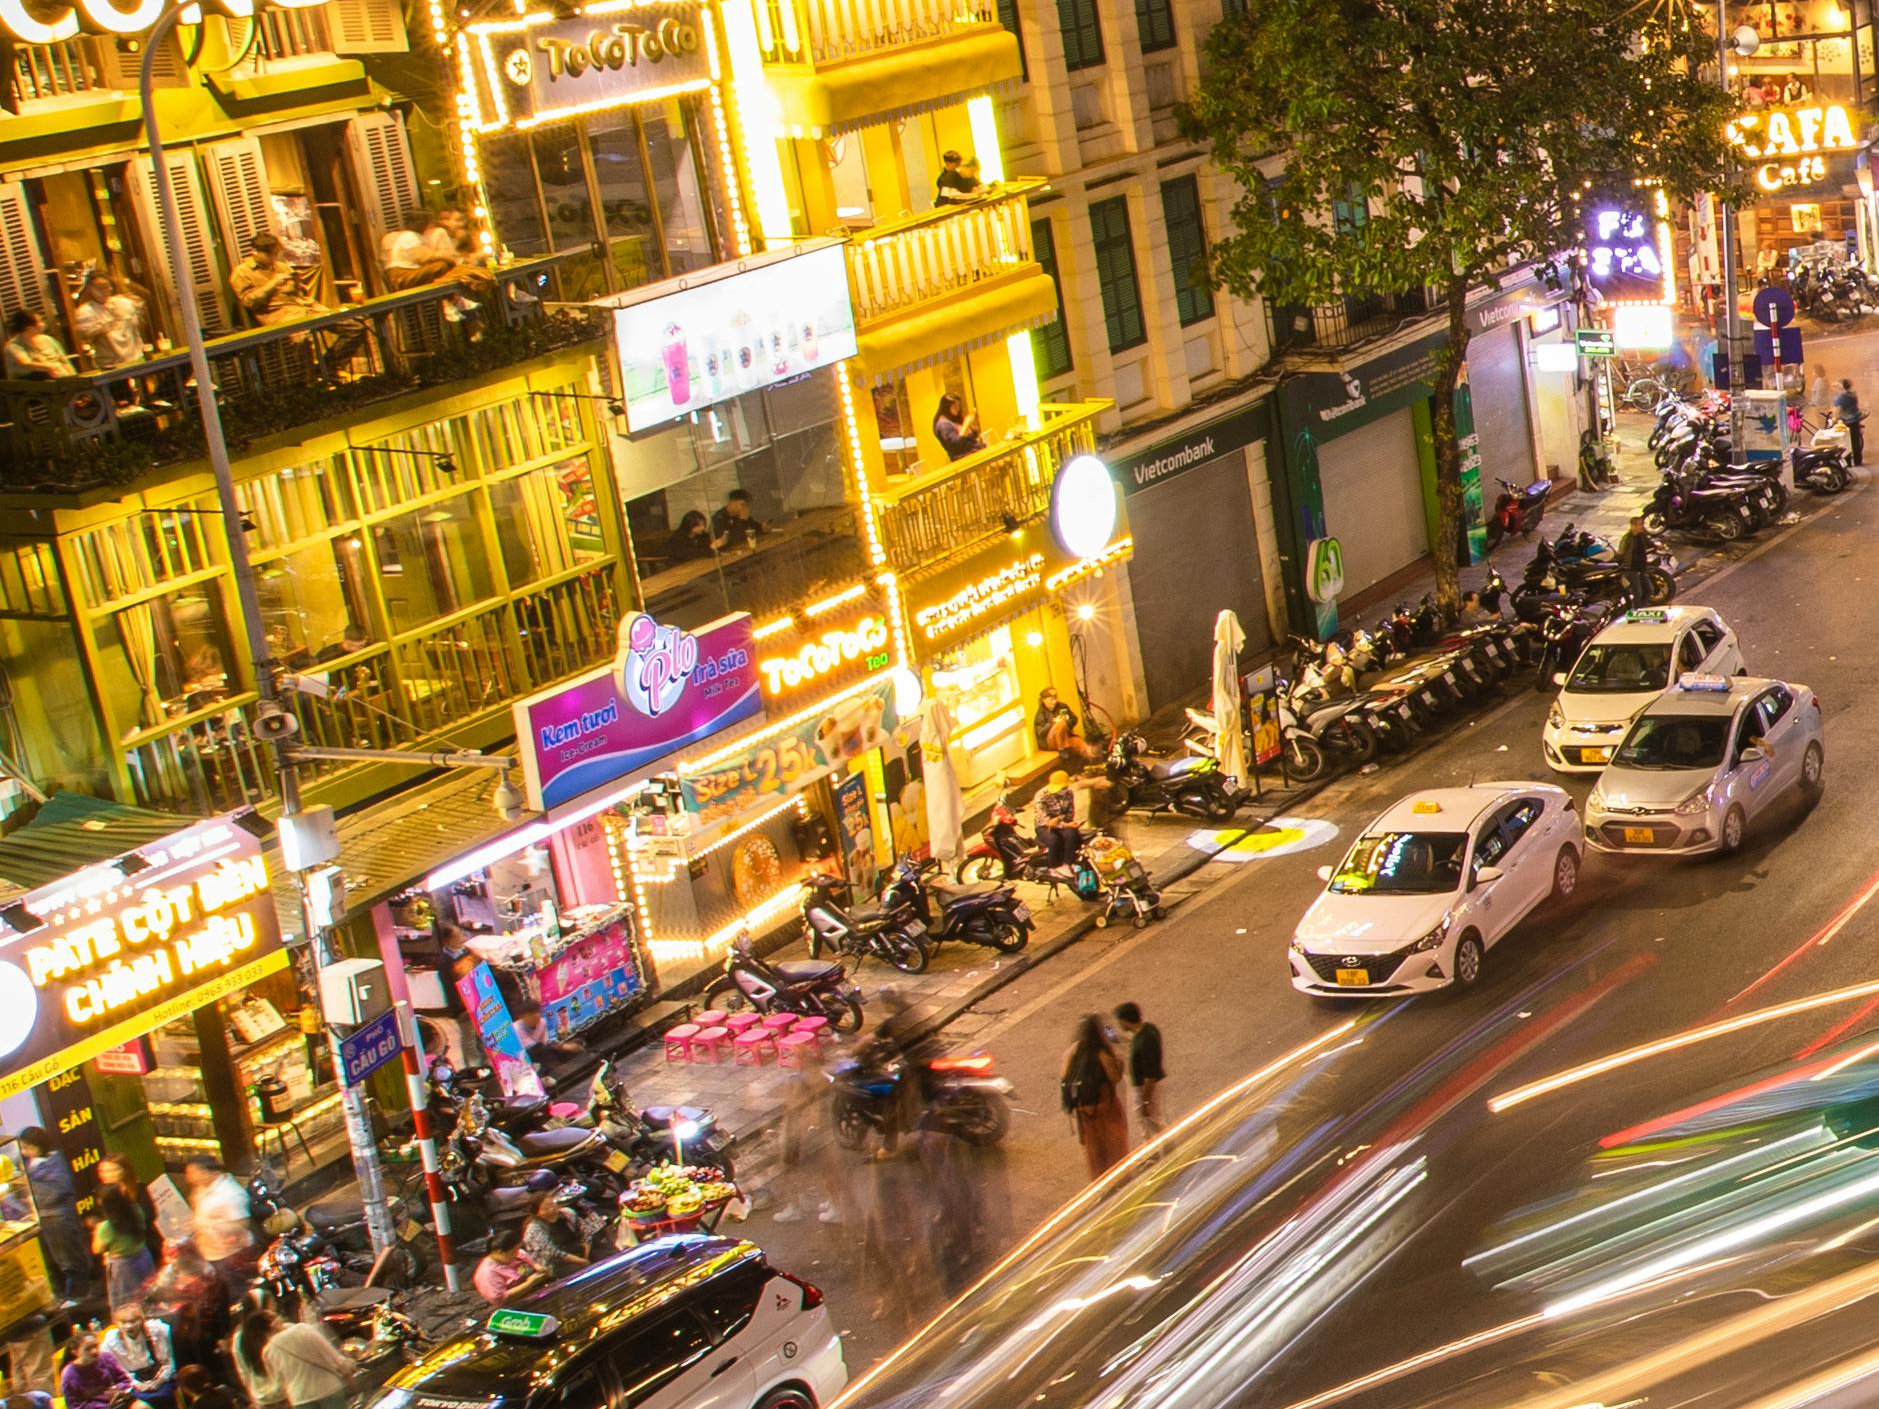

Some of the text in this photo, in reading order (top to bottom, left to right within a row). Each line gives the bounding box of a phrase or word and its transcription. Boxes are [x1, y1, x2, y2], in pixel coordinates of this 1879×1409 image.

[1133, 436, 1216, 485] Vietcombank
[692, 656, 717, 687] Trà
[541, 698, 619, 751] Kem tươi
[696, 769, 740, 804] Size
[119, 885, 193, 942] CỘT
[58, 1107, 94, 1135] SẢN
[72, 1147, 101, 1174] HẢI
